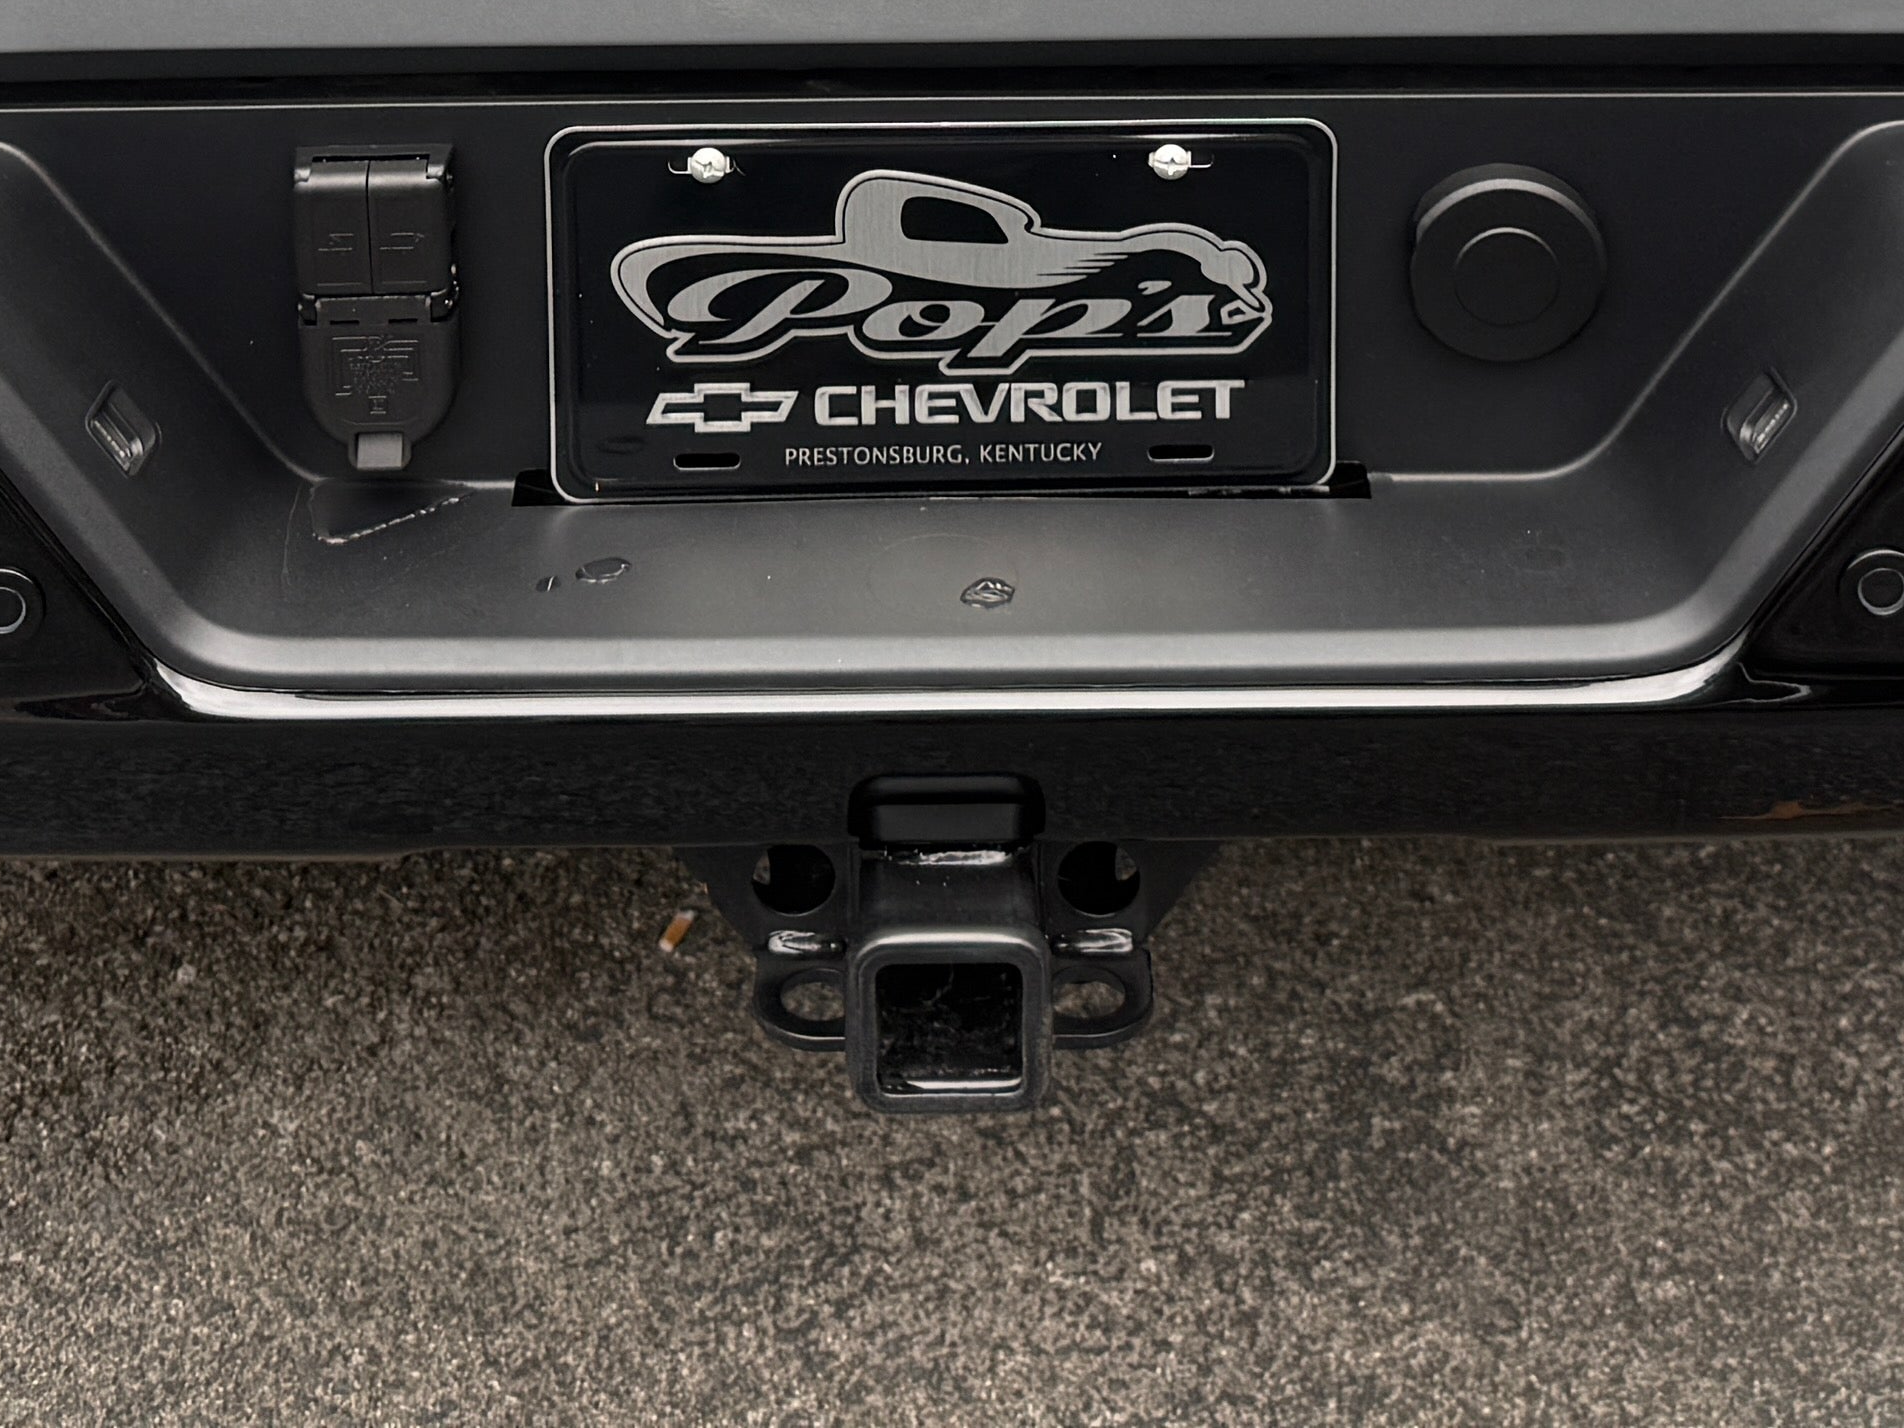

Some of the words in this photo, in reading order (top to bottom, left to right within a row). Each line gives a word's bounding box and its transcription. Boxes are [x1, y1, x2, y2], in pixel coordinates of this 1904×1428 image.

[666, 267, 1234, 358] Pop's
[813, 378, 1247, 427] CHEVROLET
[783, 443, 971, 467] PRESTONSBURG,
[979, 441, 1103, 465] KENTUCKY
